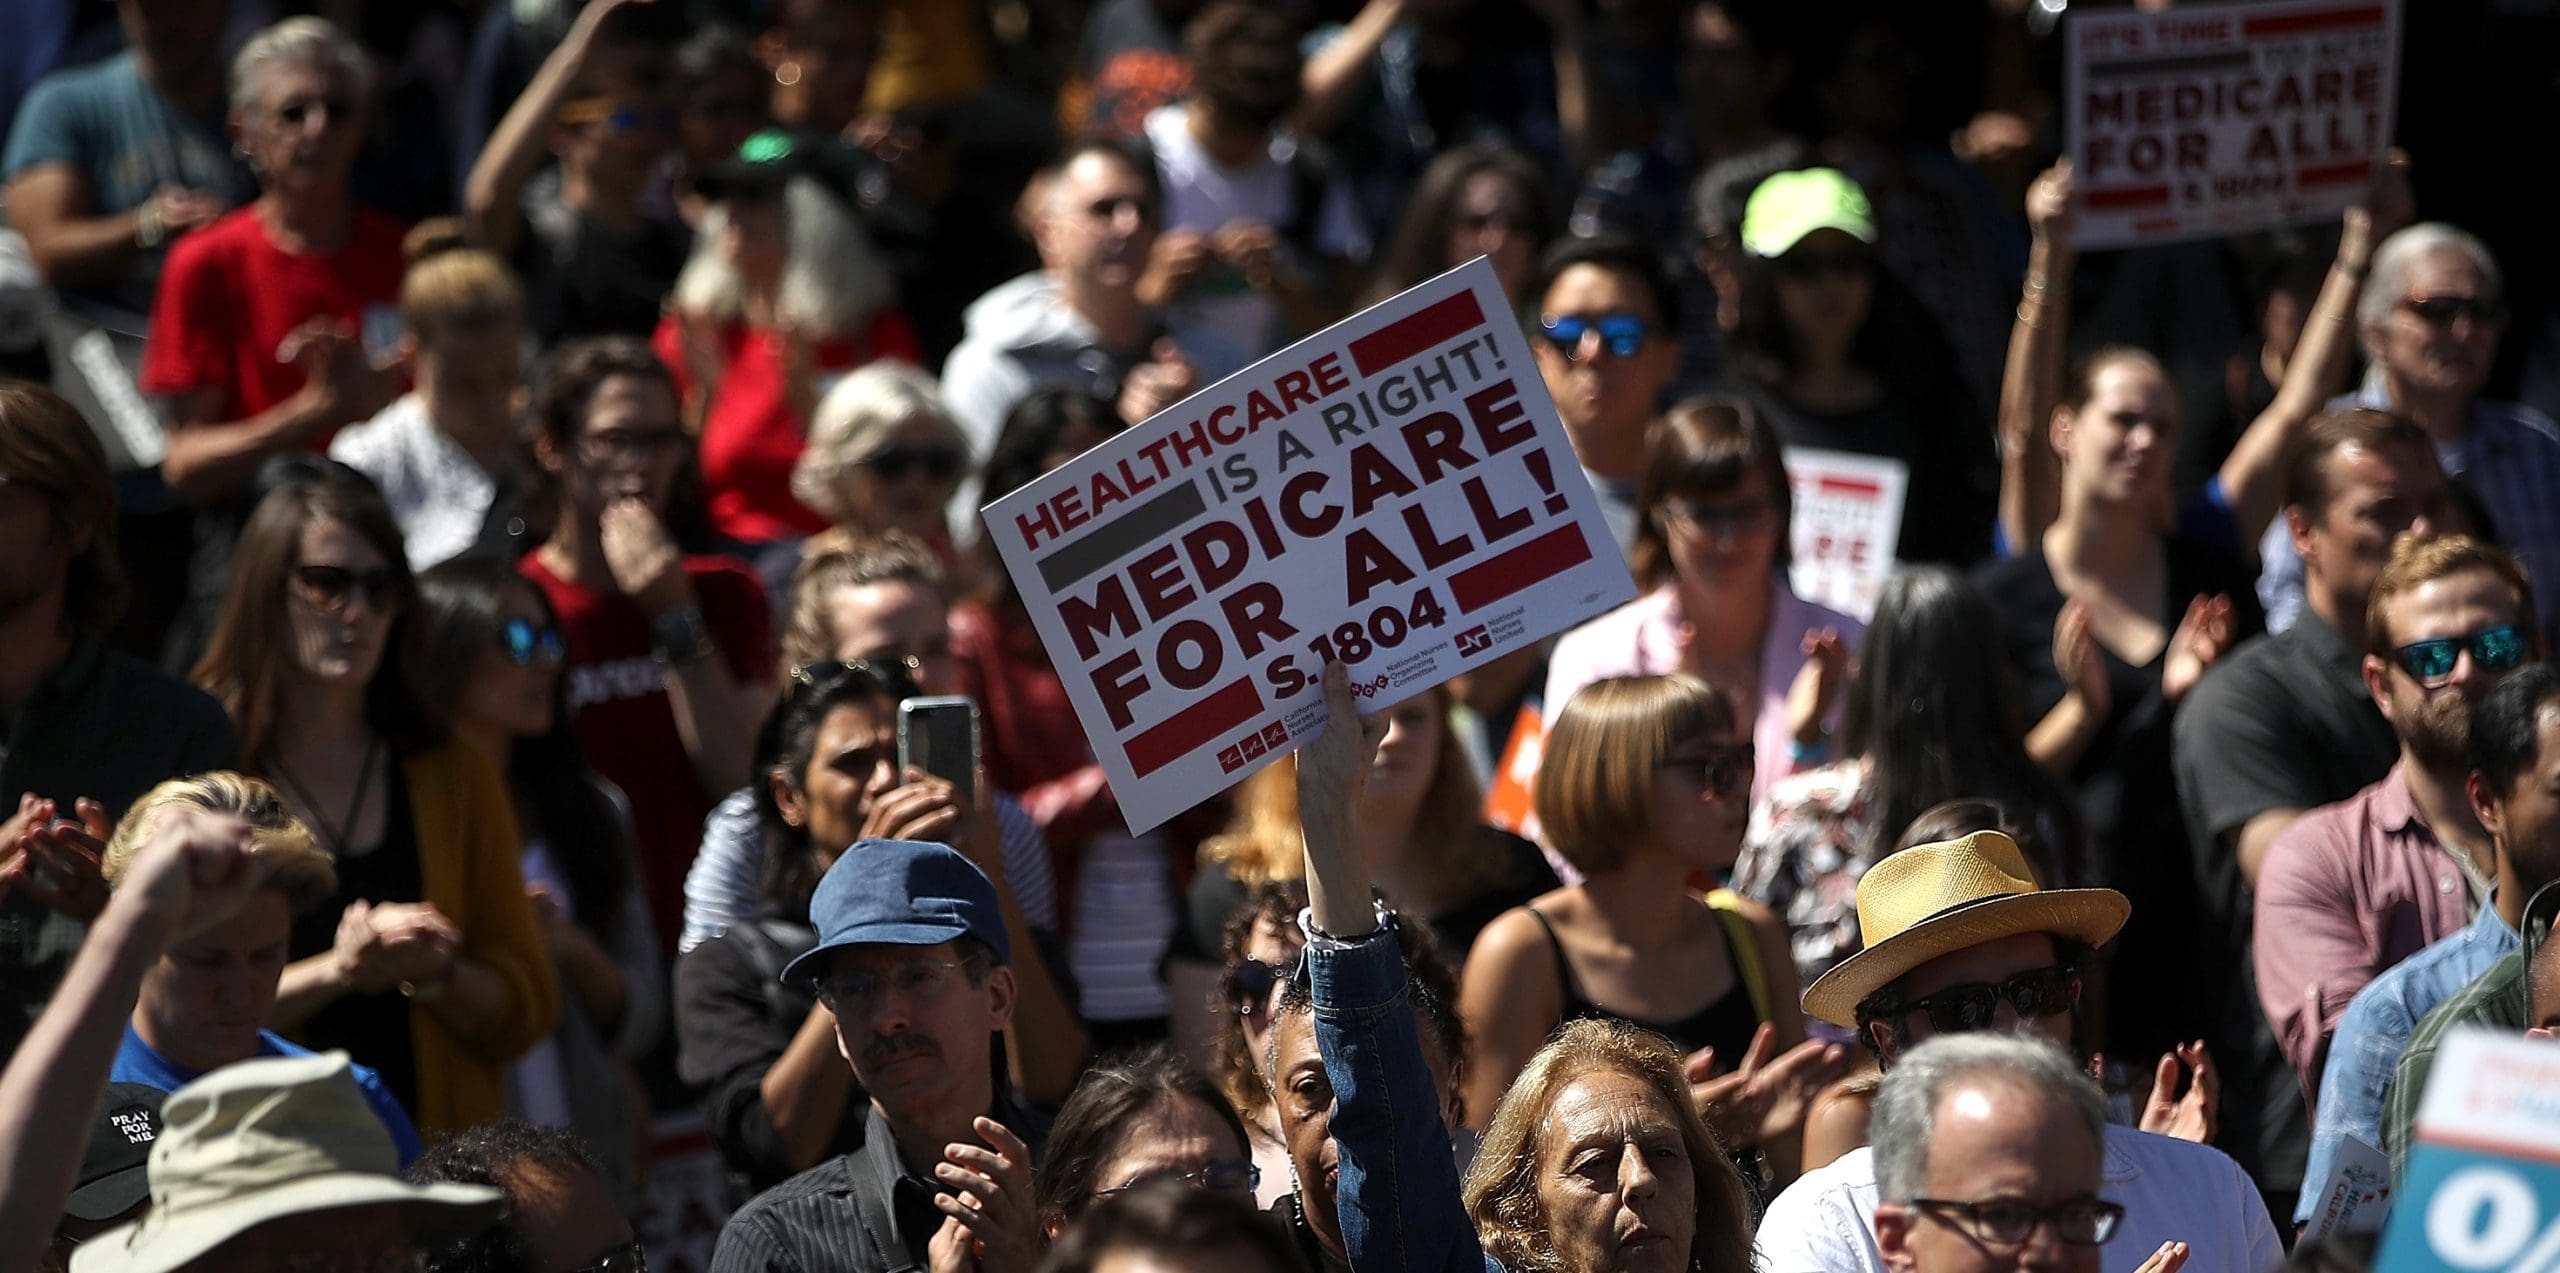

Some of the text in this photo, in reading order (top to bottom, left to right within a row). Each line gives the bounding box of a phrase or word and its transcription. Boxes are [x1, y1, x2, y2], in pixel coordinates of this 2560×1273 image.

[2085, 62, 2380, 126] MEDICARE
[2085, 111, 2380, 177] FOR ALL!
[1206, 332, 1507, 503] IS A RIGHT!
[1015, 351, 1350, 551] HEALTHCARE
[1056, 377, 1538, 662] MEDICARE
[1090, 447, 1569, 733] FOR ALL!
[1487, 605, 1526, 627] National
[1491, 619, 1523, 634] Nurses
[1266, 587, 1447, 700] S.1804
[1495, 626, 1526, 644] United
[1386, 641, 1449, 672] National Nurses
[1390, 656, 1434, 681] Organizing
[1393, 665, 1438, 688] Committee
[1284, 699, 1324, 723] California
[1288, 712, 1316, 730] Nurses
[1291, 714, 1330, 738] Associati
[110, 1111, 150, 1127] PRAY
[121, 1122, 152, 1135] FOR
